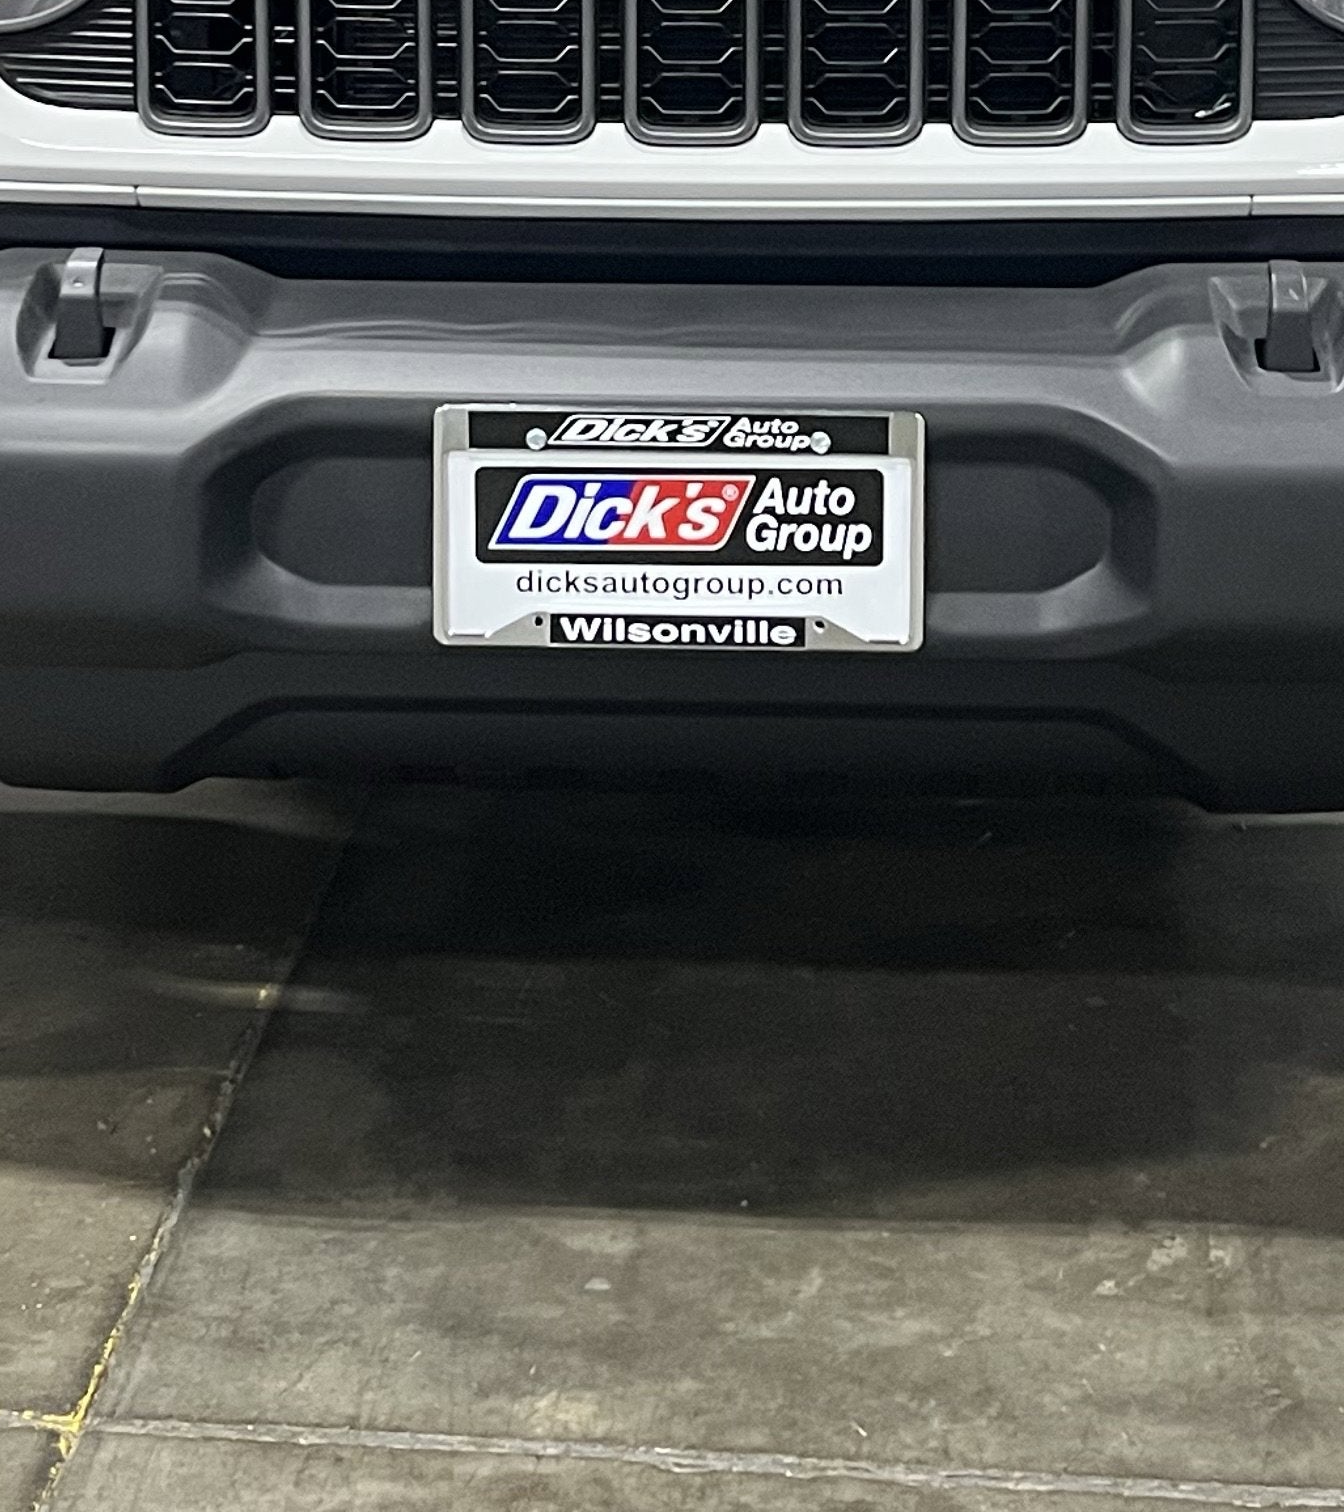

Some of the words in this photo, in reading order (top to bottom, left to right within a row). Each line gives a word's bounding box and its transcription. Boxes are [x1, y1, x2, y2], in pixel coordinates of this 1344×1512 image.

[722, 431, 811, 451] Group
[728, 416, 799, 435] Auto
[507, 482, 727, 541] Dick's
[752, 477, 856, 516] Auto
[745, 513, 873, 560] Group
[515, 569, 844, 601] dicksautogroup.com
[559, 616, 797, 646] Wilsonville
